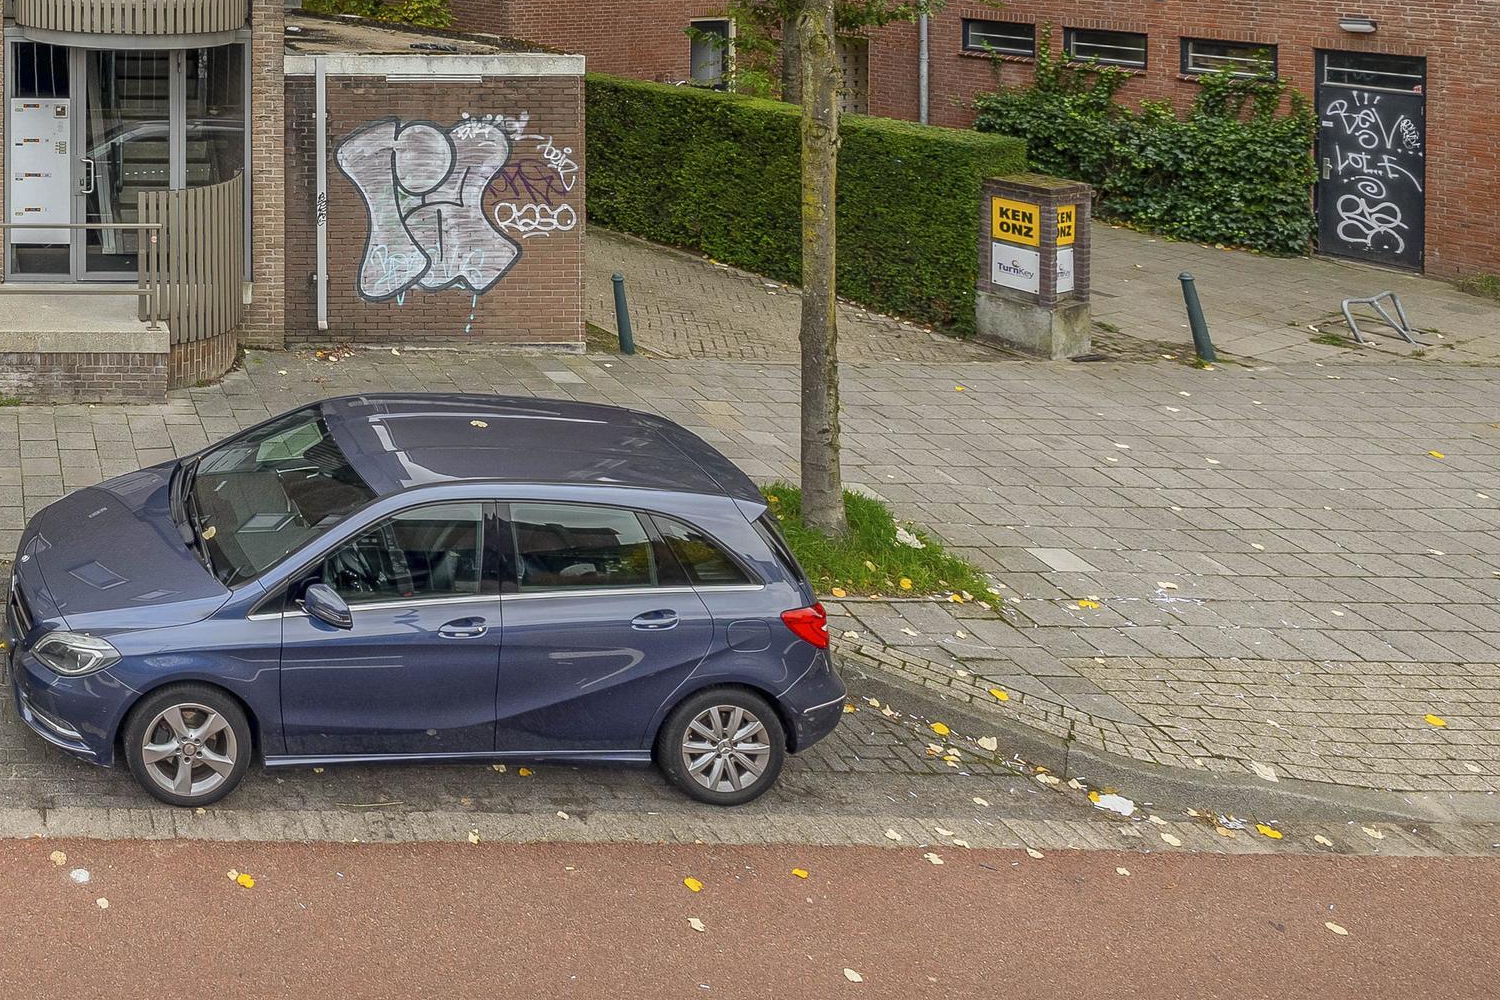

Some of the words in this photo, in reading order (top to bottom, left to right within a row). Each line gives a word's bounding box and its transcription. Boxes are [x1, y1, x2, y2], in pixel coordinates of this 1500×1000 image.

[998, 206, 1033, 224] KEN
[998, 221, 1034, 238] ONZ
[997, 262, 1035, 280] TurnKey
